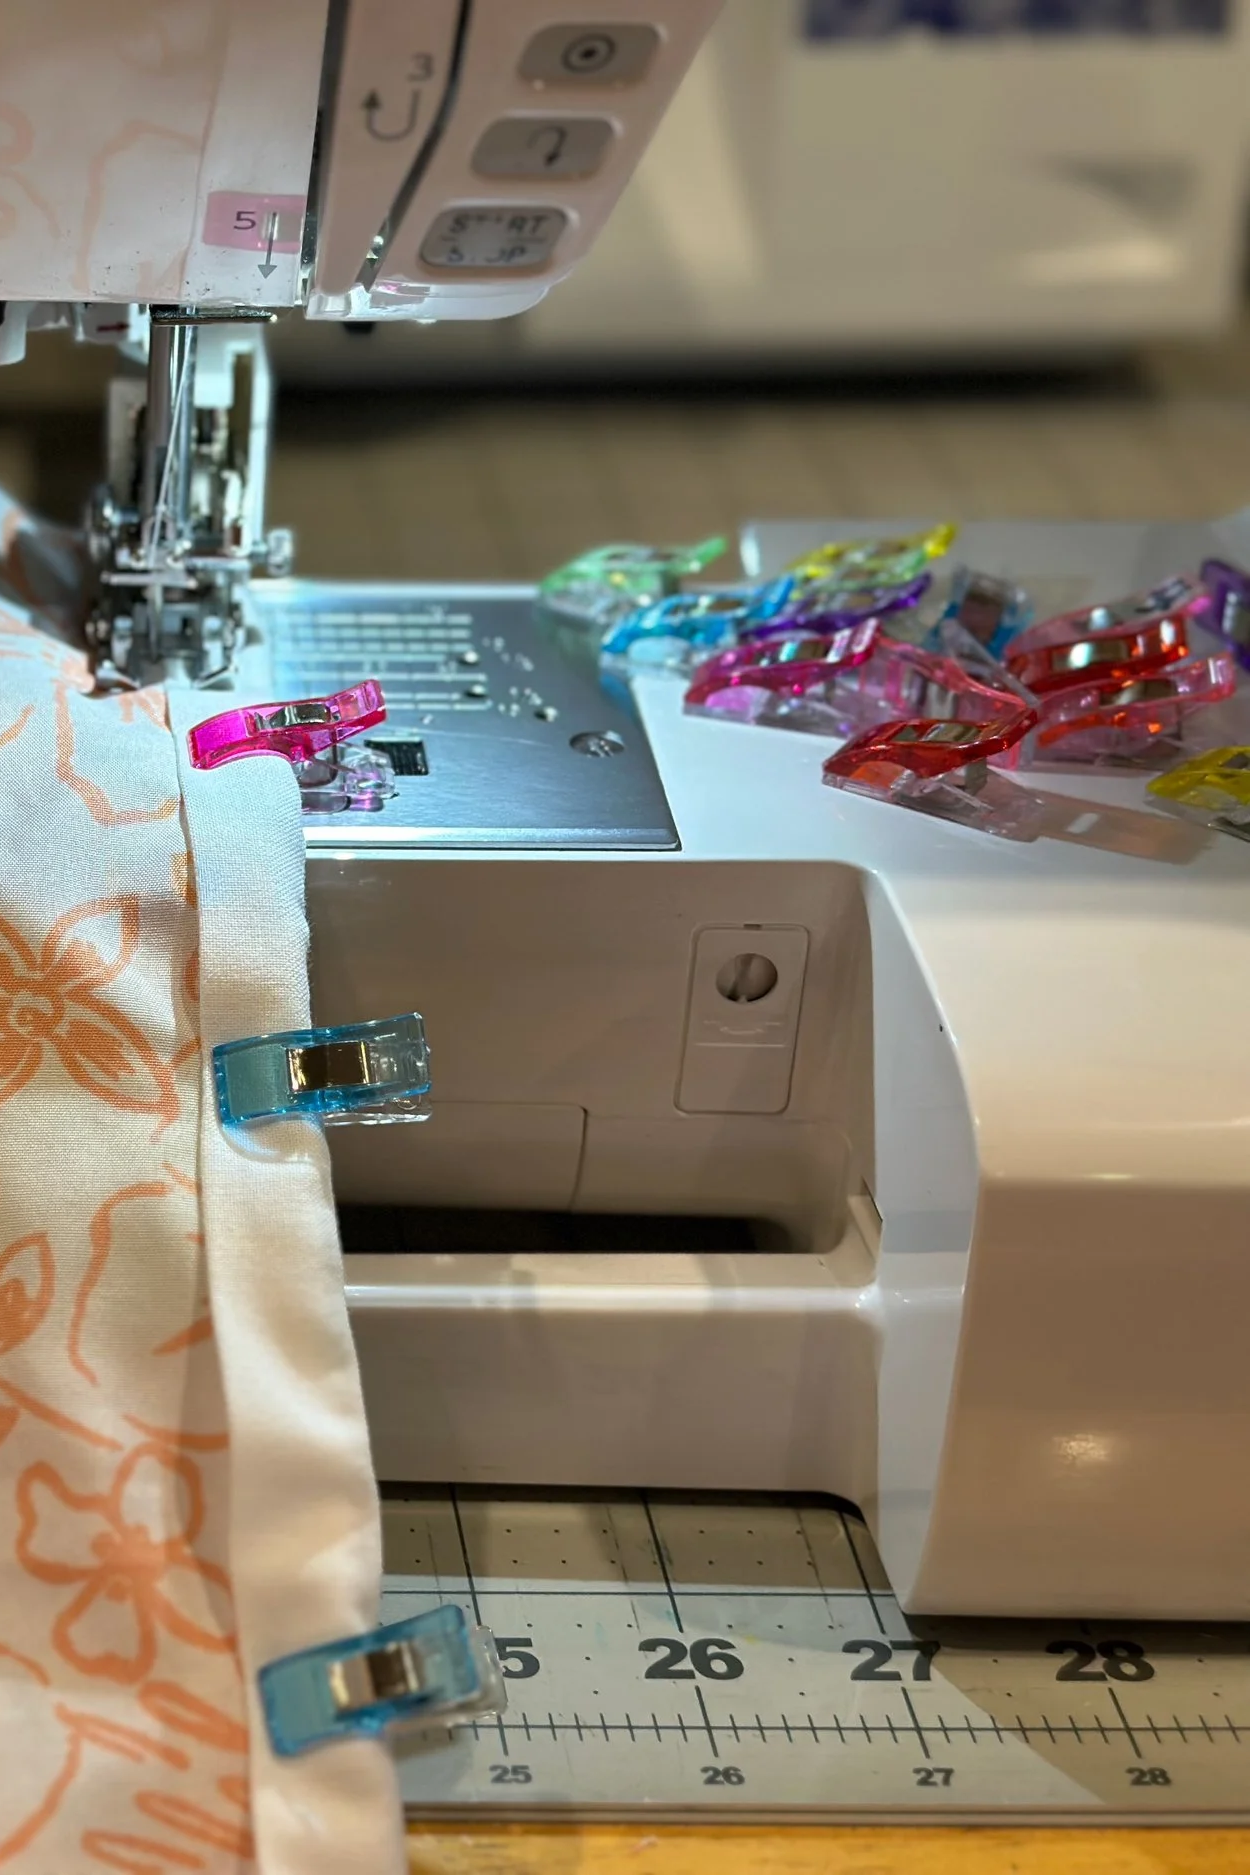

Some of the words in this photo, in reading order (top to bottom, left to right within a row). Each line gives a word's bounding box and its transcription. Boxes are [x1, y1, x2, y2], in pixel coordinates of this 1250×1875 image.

[406, 51, 435, 82] 3
[234, 210, 256, 230] 5
[495, 1637, 540, 1679] 5
[637, 1637, 745, 1681] 26
[841, 1639, 941, 1682] 27
[1045, 1639, 1155, 1682] 28
[488, 1764, 533, 1785] 25
[700, 1765, 746, 1786] 26
[911, 1767, 955, 1787] 27
[1125, 1766, 1172, 1787] 28
